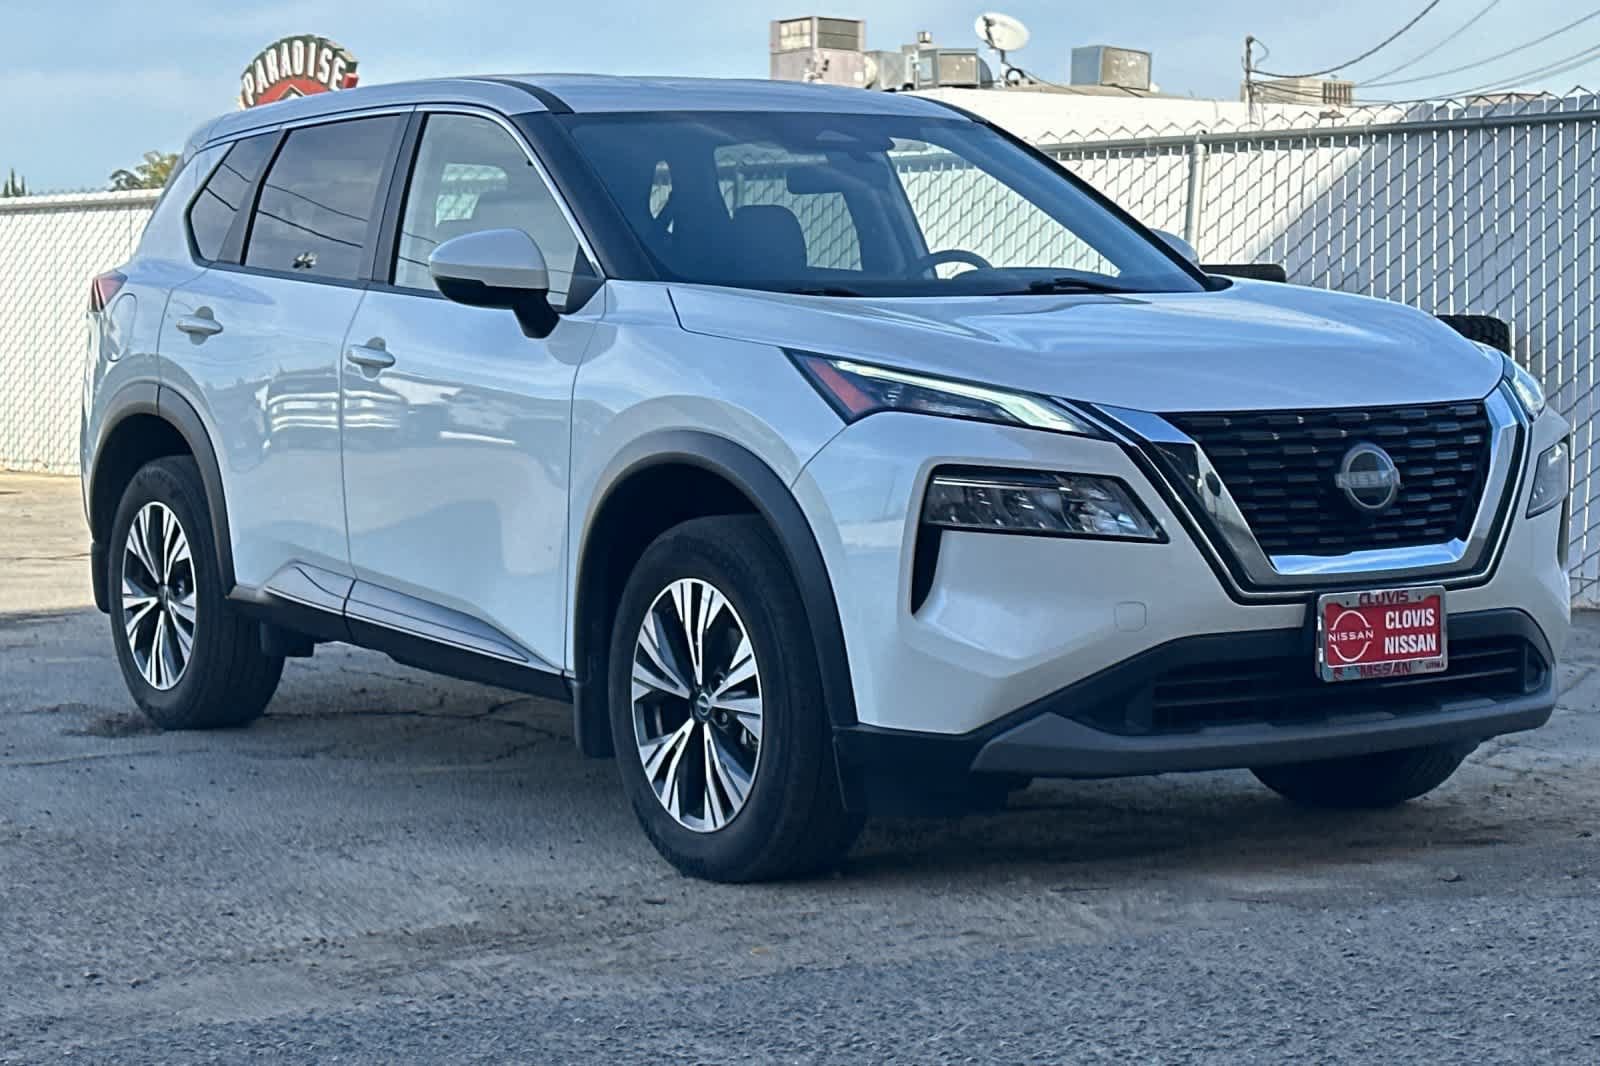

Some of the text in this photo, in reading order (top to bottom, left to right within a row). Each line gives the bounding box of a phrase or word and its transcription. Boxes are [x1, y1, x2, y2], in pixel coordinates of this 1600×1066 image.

[243, 40, 347, 106] PARADISE
[1359, 590, 1409, 605] CLOVIS
[1385, 608, 1435, 629] CLOVIS
[1328, 629, 1374, 642] NISSAN
[1384, 633, 1437, 655] NISSAN
[1360, 661, 1412, 678] NISSAN
